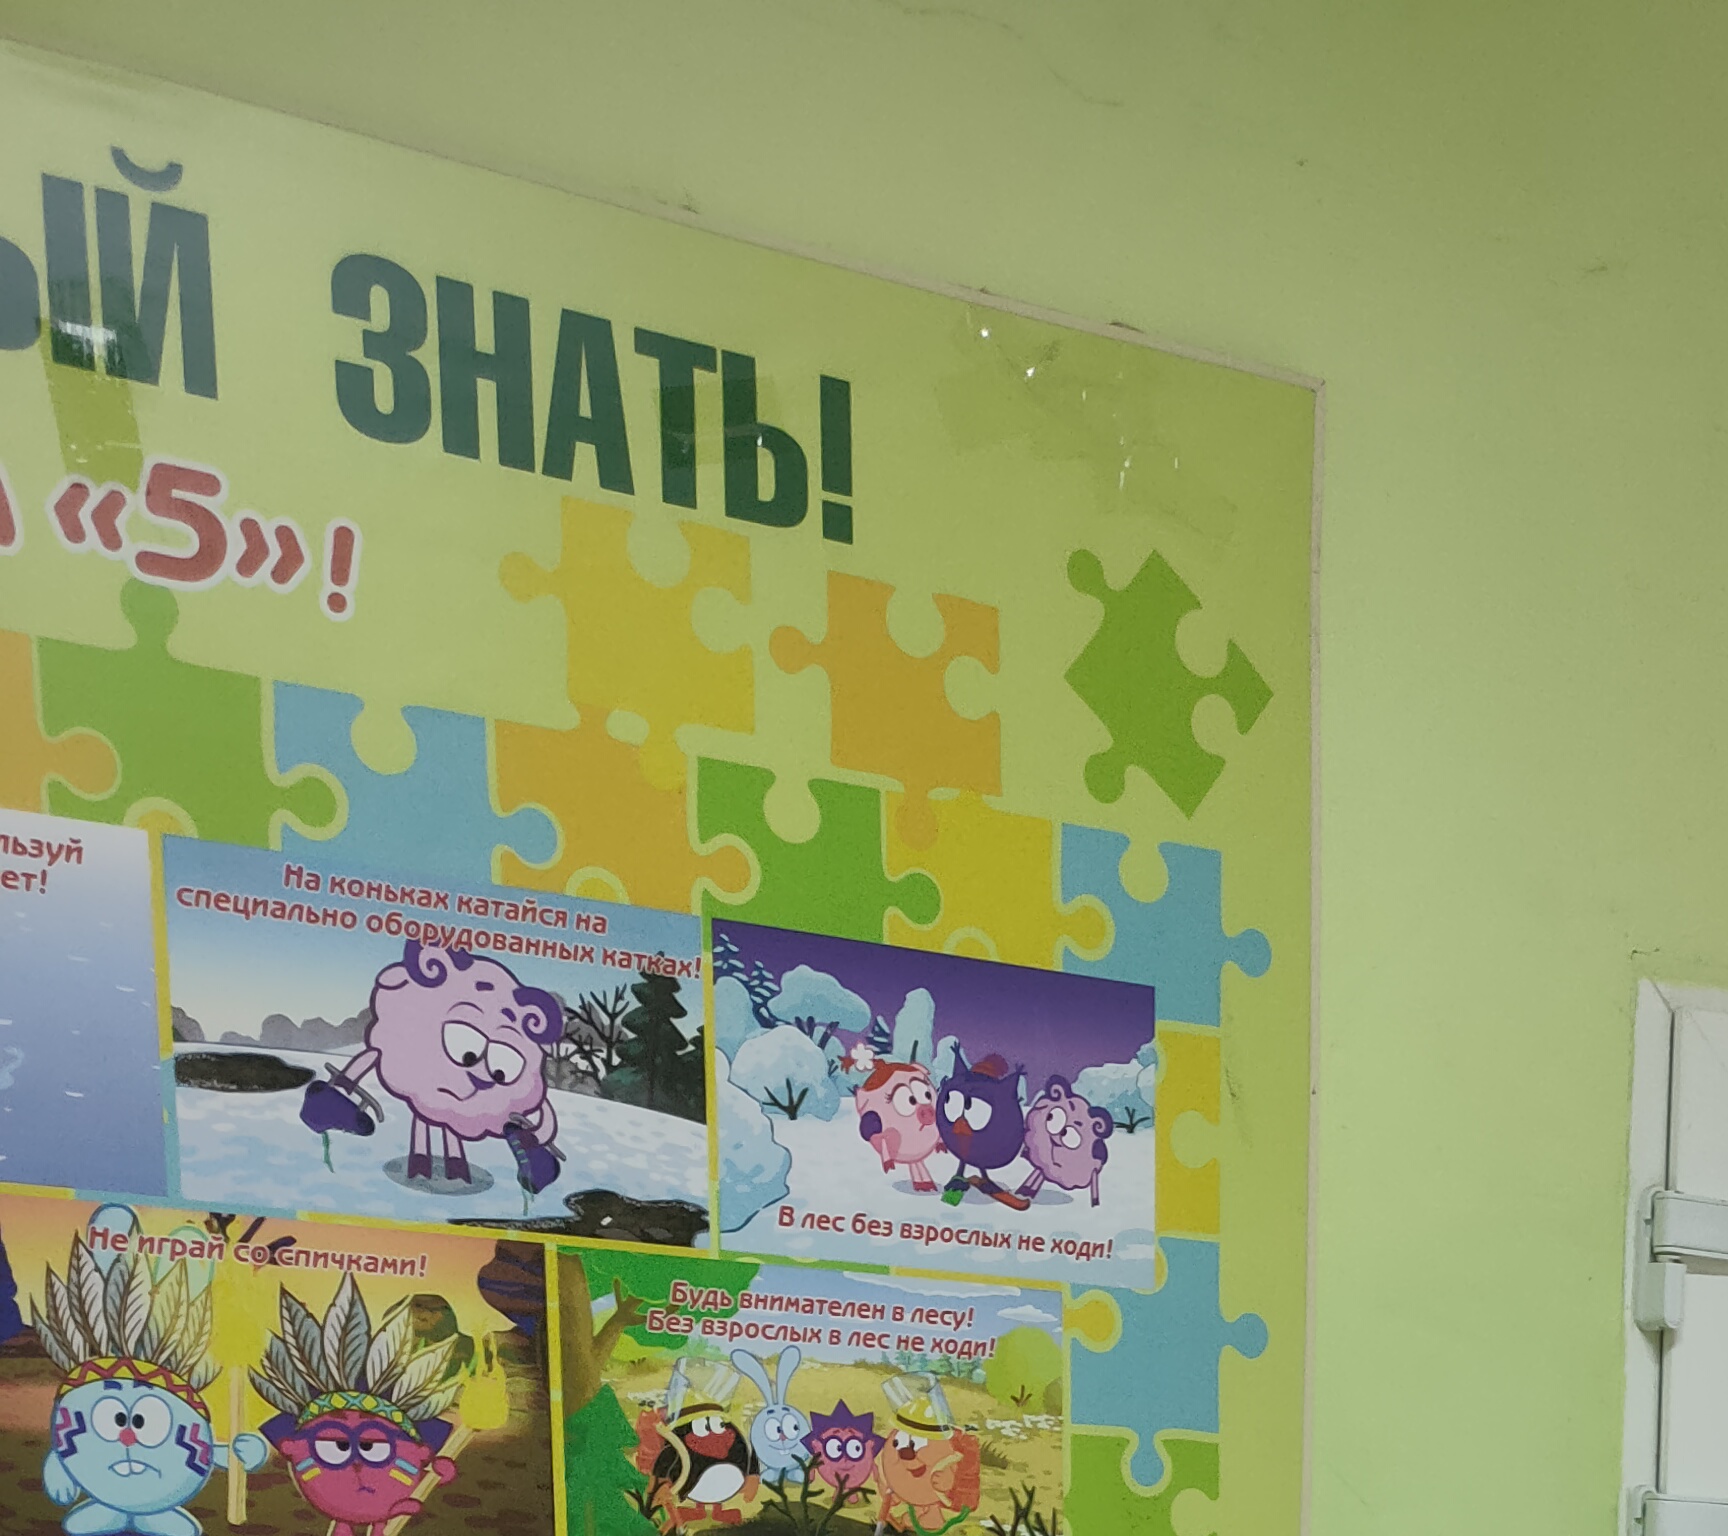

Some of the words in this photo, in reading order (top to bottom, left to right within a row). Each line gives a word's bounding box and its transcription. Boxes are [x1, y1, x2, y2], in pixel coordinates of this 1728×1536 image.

[331, 253, 853, 545] ЗНАТЬ!
[283, 863, 321, 892] На
[329, 875, 449, 911] коньках
[456, 894, 568, 929] катайся
[575, 913, 607, 935] на
[176, 887, 357, 930] специально
[365, 912, 594, 964] оборудованных
[602, 948, 702, 980] катках!
[88, 1226, 128, 1252] Не
[137, 1235, 225, 1261] играй
[234, 1240, 268, 1264] со
[278, 1247, 427, 1278] спичками!
[778, 1205, 795, 1227] В
[801, 1212, 845, 1233] лес
[851, 1212, 893, 1238] без
[901, 1222, 1011, 1249] взрослых
[1018, 1234, 1045, 1253] не
[1051, 1238, 1113, 1261] ходи!
[670, 1281, 733, 1310] Будь
[740, 1292, 886, 1321] внимателен
[891, 1304, 905, 1322] в
[911, 1307, 975, 1331] лесу!
[646, 1310, 694, 1334] Без
[701, 1318, 822, 1344] взрослых
[828, 1327, 841, 1345] в
[848, 1329, 890, 1350] лес
[896, 1334, 925, 1353] не
[930, 1338, 996, 1359] ходи!
